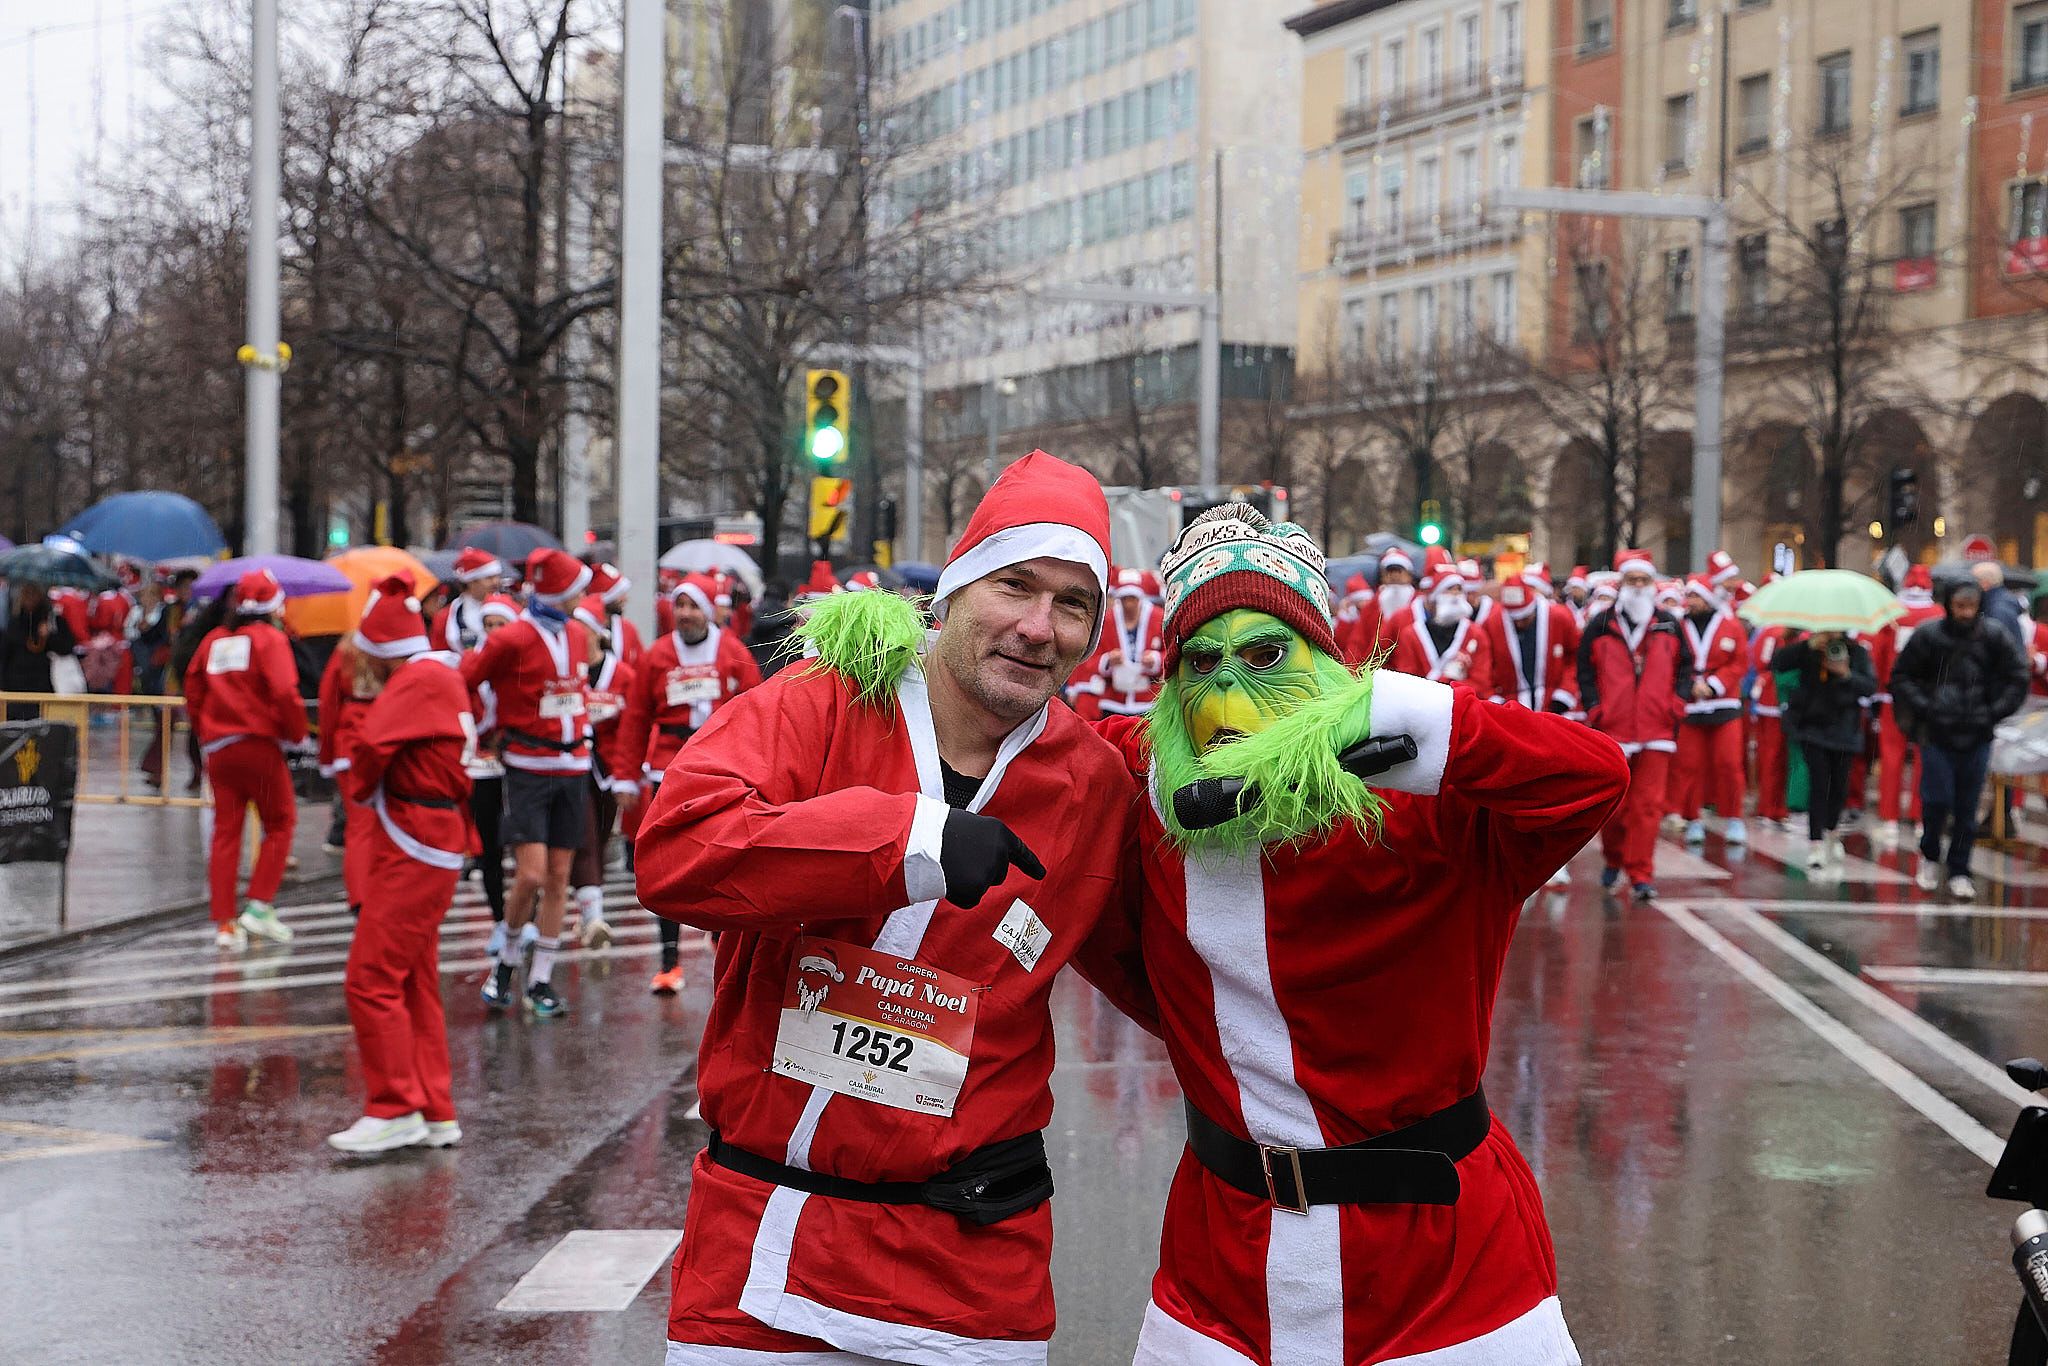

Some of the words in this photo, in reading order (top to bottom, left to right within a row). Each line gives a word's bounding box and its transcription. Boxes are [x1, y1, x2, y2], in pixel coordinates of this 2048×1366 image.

[1001, 923, 1021, 943] CAJA
[1002, 936, 1013, 947] DE
[896, 962, 939, 981] CARRERA
[854, 965, 915, 998] Papá
[918, 983, 969, 1014] Noel
[877, 1001, 903, 1015] CAJA
[904, 1007, 937, 1024] RURAL
[881, 1013, 892, 1022] DE
[831, 1020, 915, 1074] 1252
[848, 1079, 864, 1090] CAJA
[864, 1084, 885, 1095] RURAL
